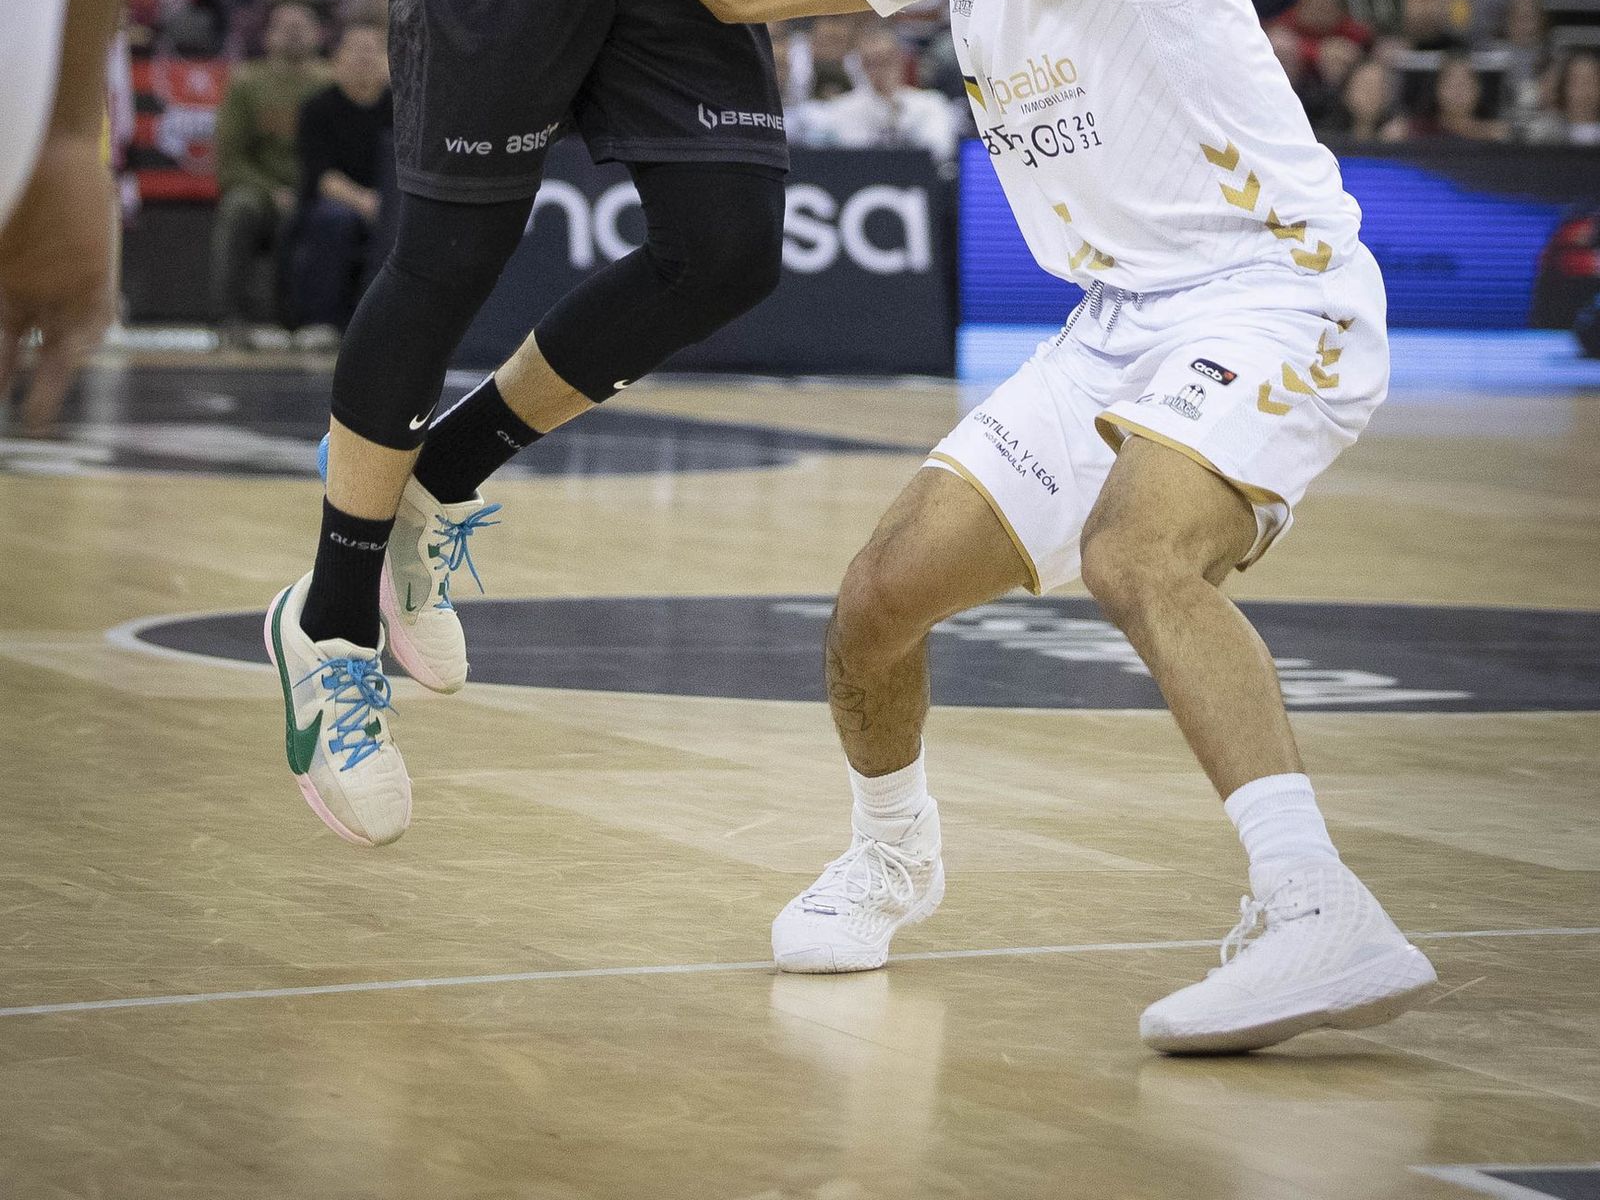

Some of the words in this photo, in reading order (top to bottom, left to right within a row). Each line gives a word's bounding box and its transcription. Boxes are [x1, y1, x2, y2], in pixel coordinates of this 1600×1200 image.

[993, 54, 1078, 115] pablo
[720, 110, 784, 131] BERNE
[445, 137, 493, 155] vive
[1194, 361, 1223, 381] acb
[1020, 450, 1034, 463] Y
[1031, 461, 1060, 496] LEÓN
